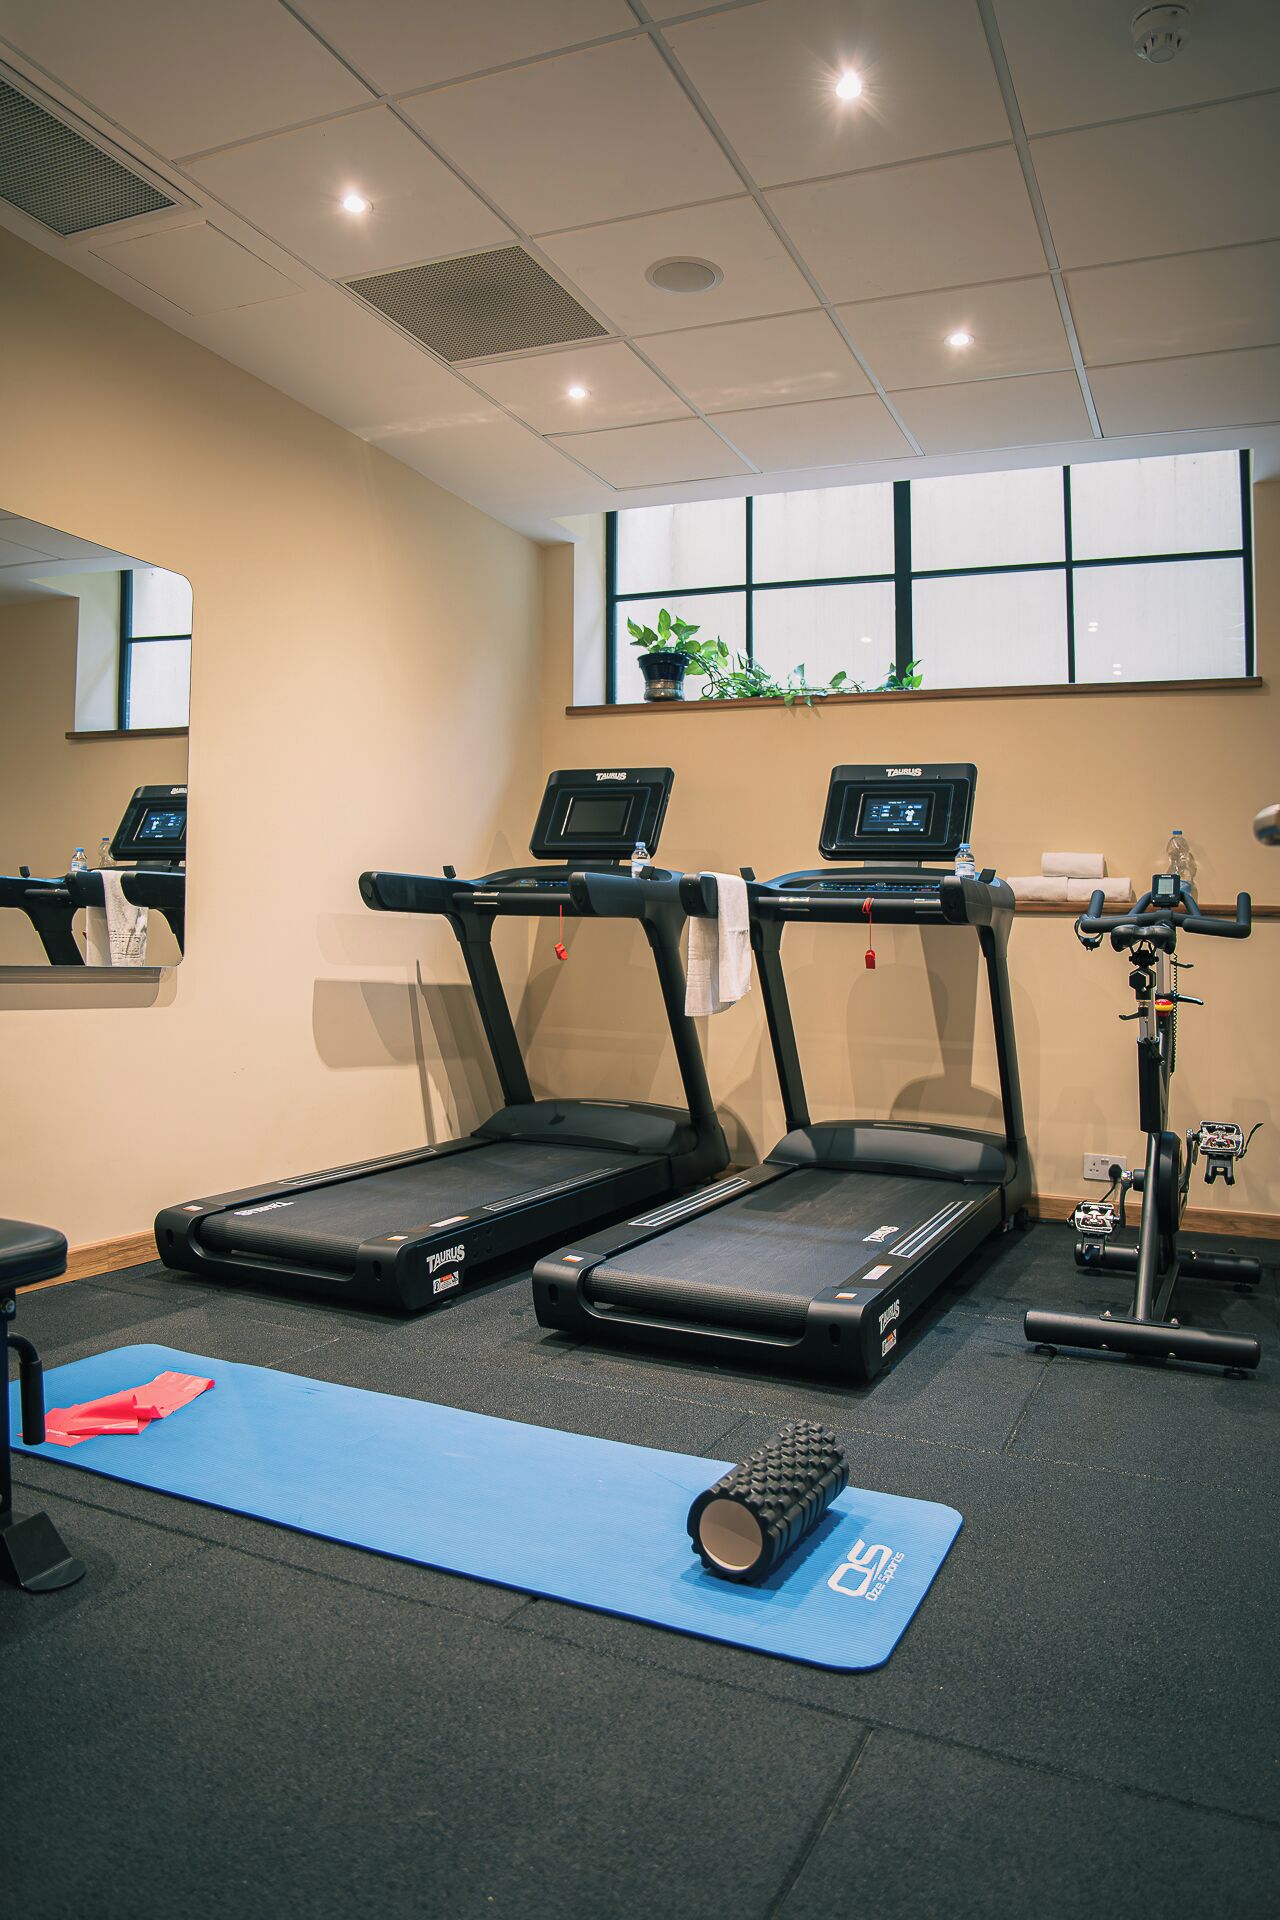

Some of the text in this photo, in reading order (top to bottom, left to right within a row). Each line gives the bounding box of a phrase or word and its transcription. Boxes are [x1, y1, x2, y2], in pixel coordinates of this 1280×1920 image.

[595, 772, 627, 781] TAURUS
[886, 767, 922, 778] TAURUS
[426, 1244, 466, 1274] TAURUS
[878, 1298, 900, 1336] TAURUS
[864, 1551, 905, 1601] Oze Sports
